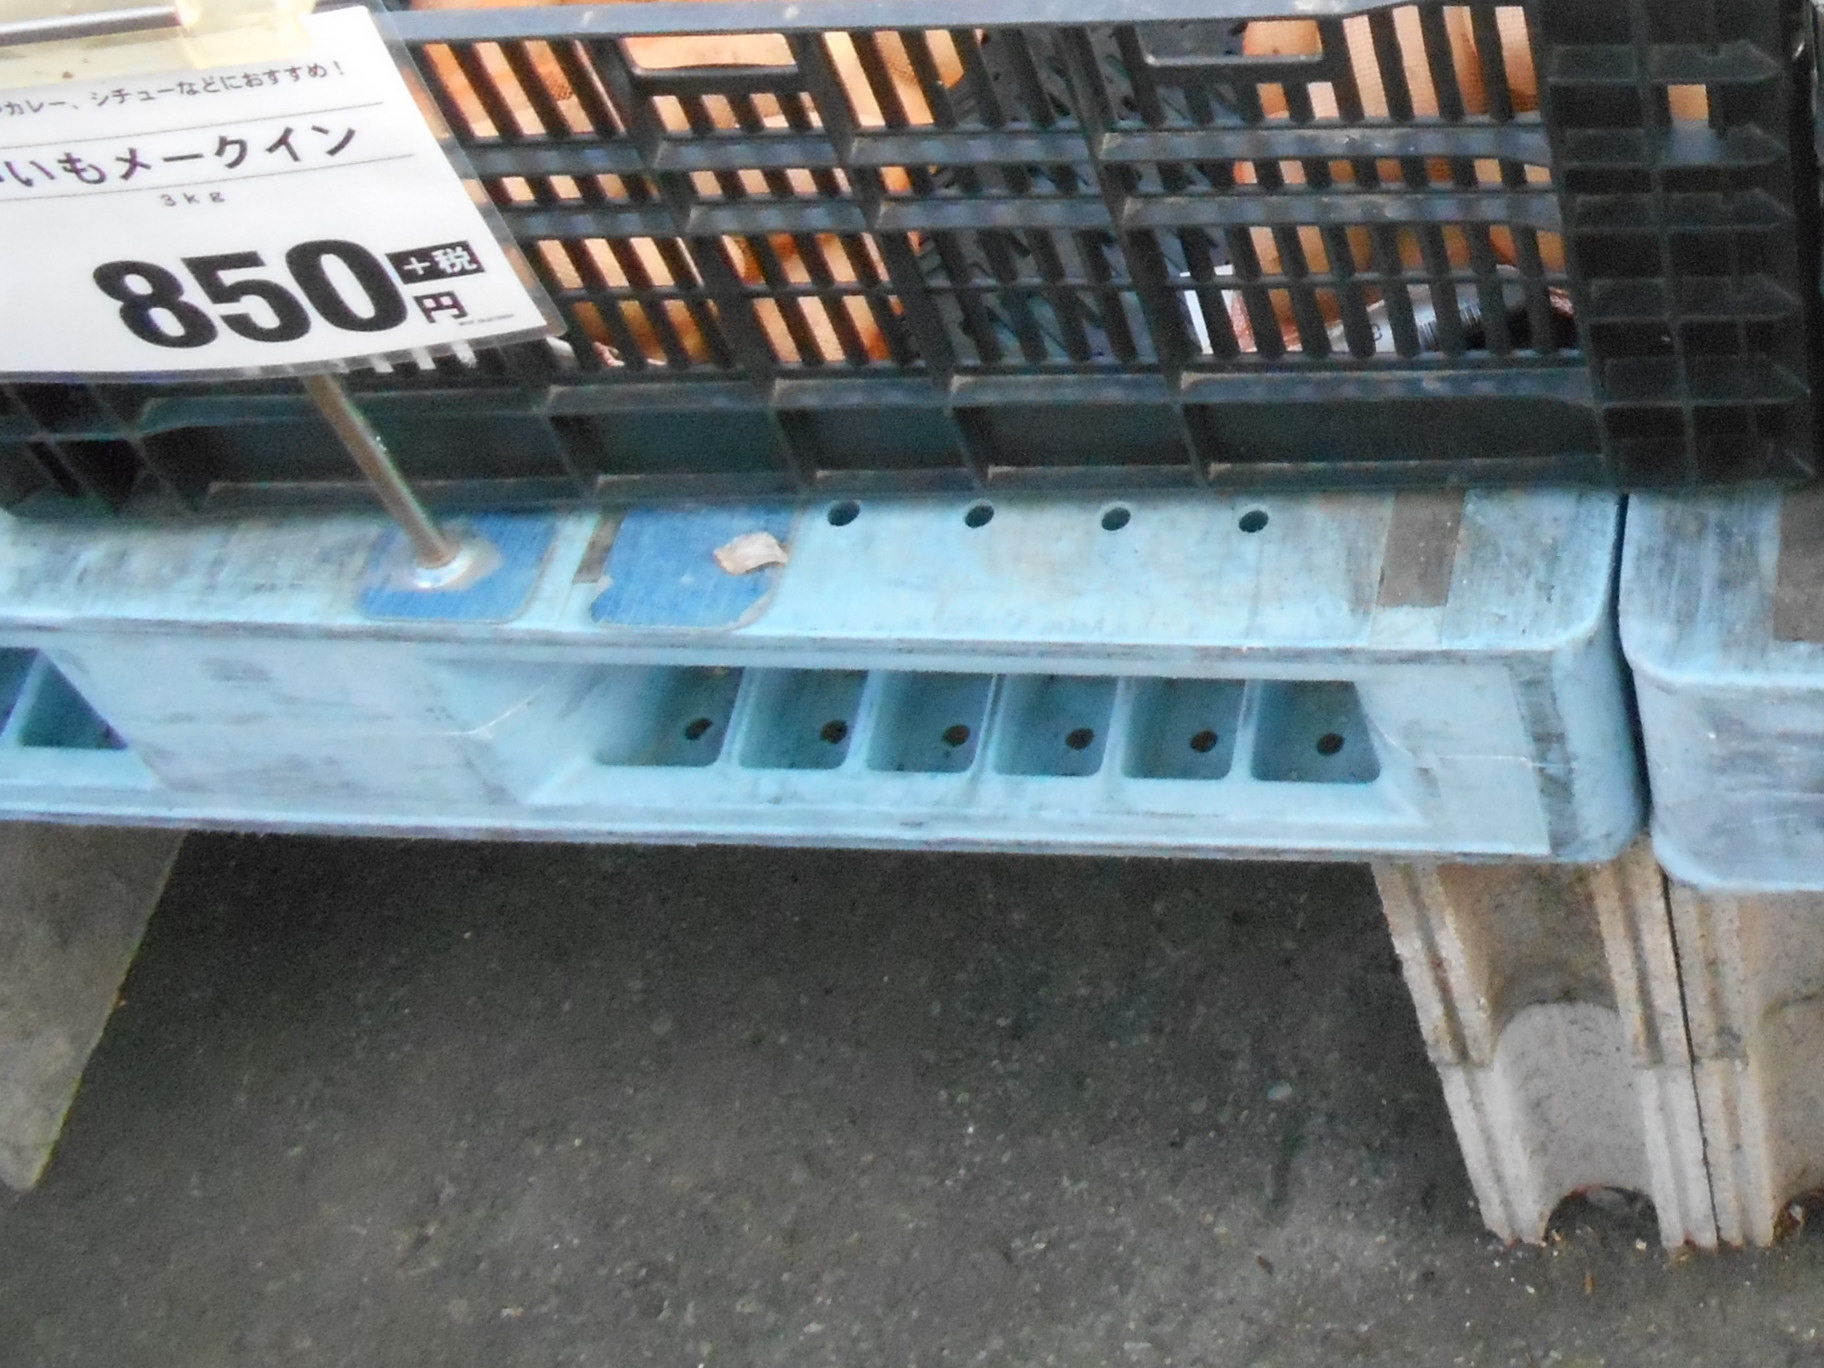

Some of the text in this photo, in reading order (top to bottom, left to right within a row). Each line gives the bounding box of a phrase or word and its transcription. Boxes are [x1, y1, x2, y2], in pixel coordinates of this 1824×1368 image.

[0, 61, 345, 116] カレー、シチューなどにおすすめ!
[0, 127, 356, 187] いもメークイン
[92, 238, 409, 349] 850
[413, 290, 469, 325] 円
